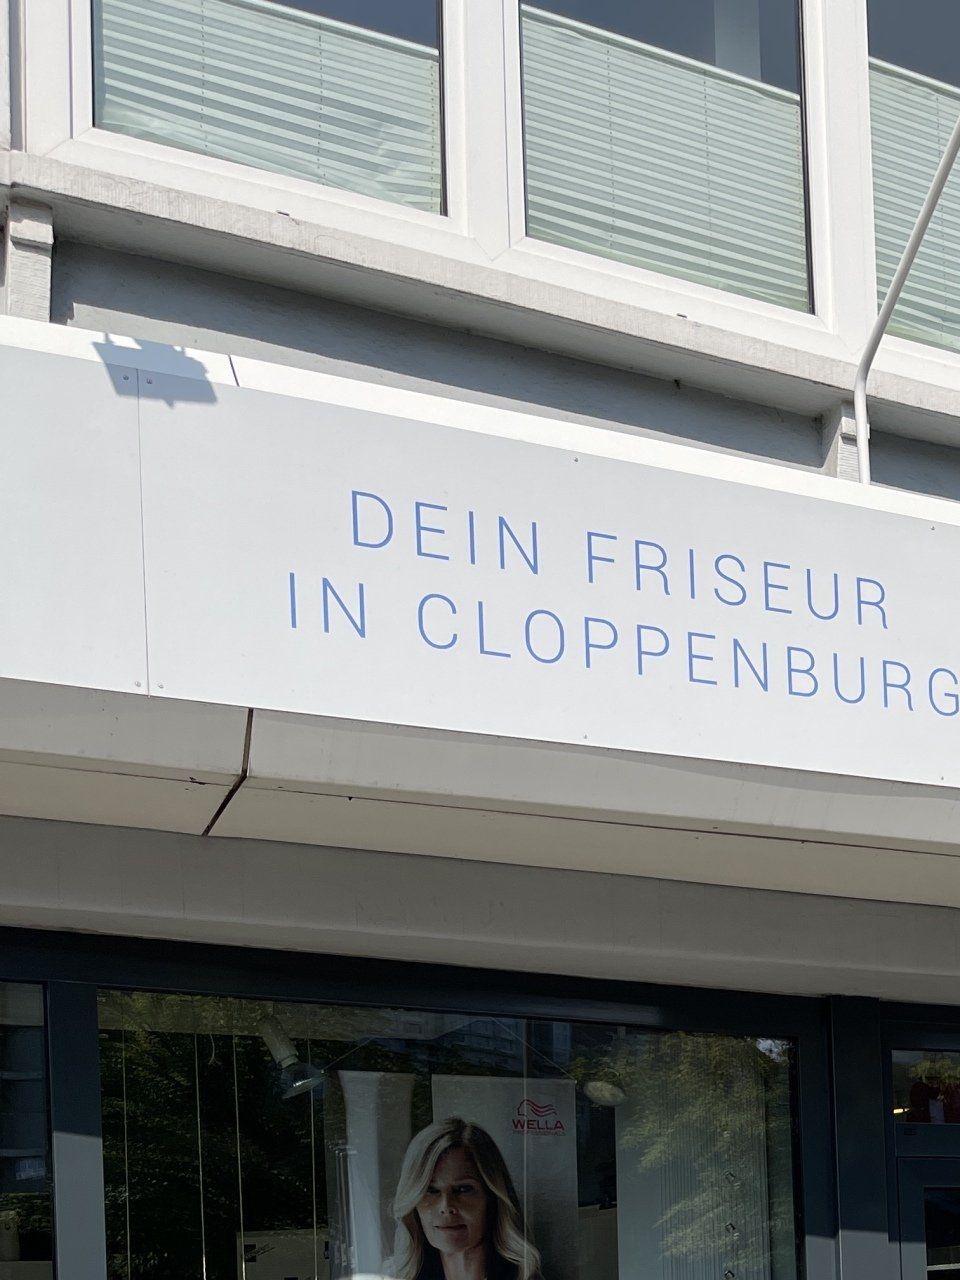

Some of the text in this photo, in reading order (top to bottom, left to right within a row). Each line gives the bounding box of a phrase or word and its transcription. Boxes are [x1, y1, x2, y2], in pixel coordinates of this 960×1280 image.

[351, 490, 889, 630] DEIN FRISEUR
[287, 572, 368, 639] IN
[512, 1119, 565, 1131] WELLA
